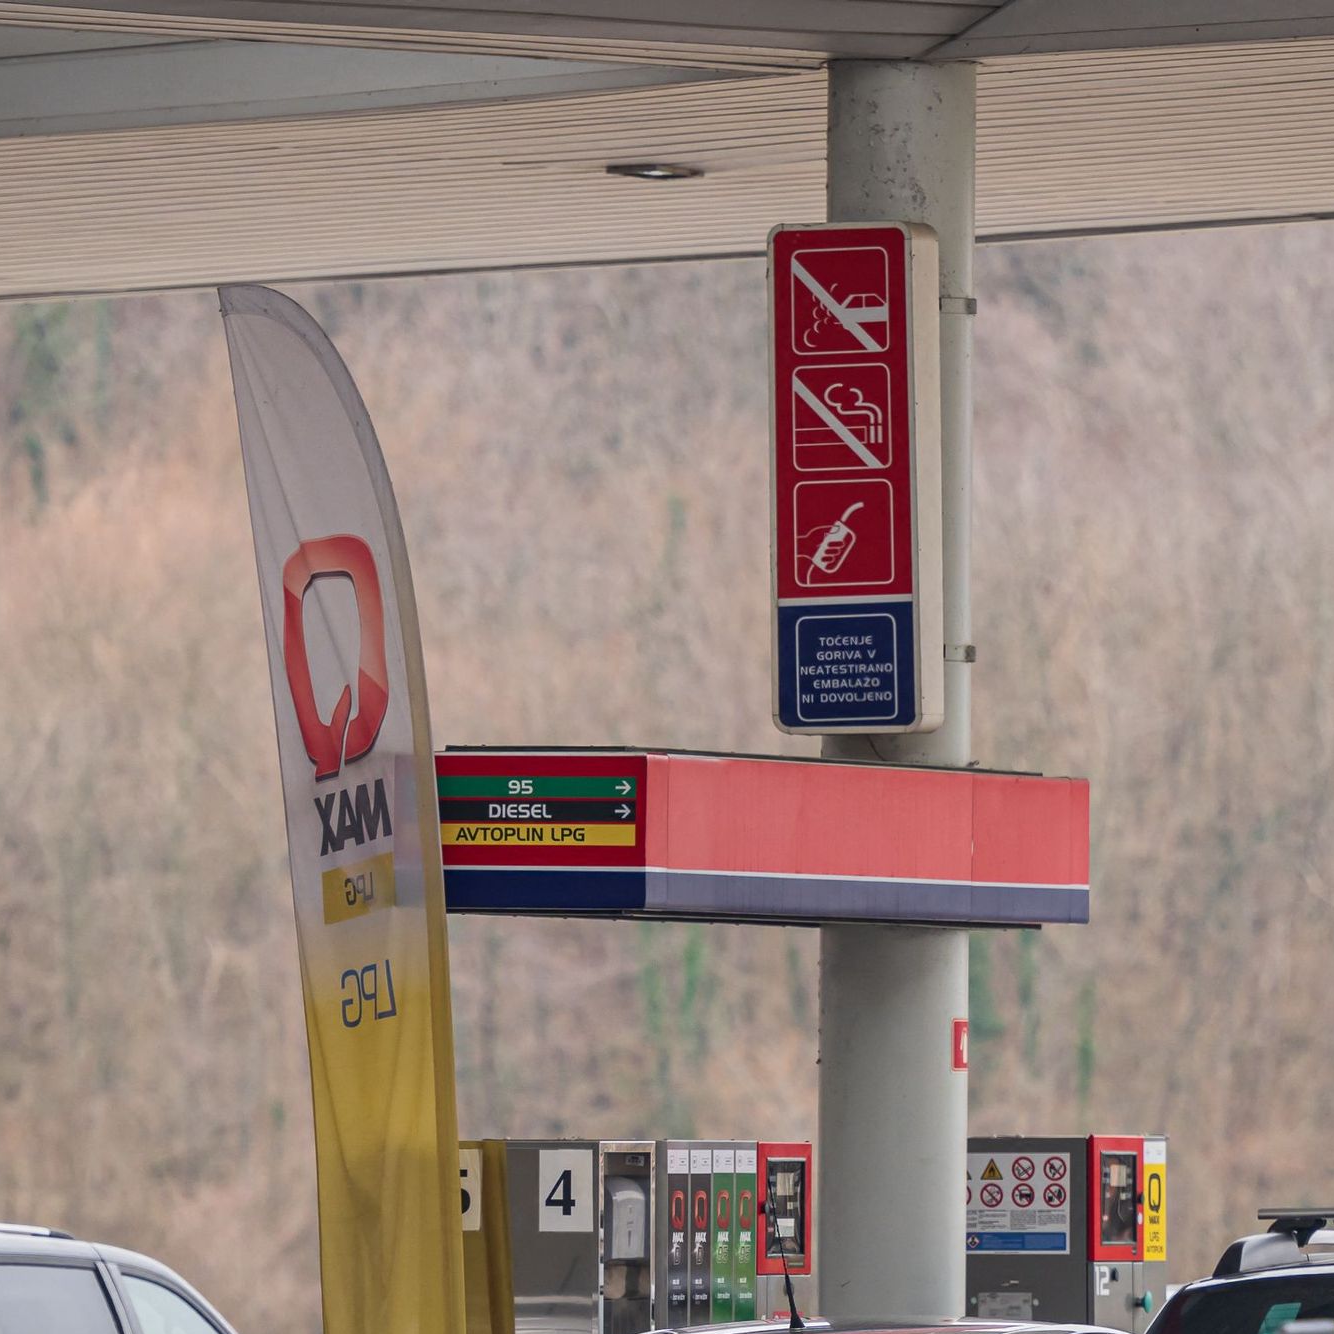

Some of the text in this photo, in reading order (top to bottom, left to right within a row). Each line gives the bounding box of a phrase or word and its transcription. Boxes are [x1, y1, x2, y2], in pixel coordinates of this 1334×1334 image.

[819, 634, 873, 647] TOČENJE
[816, 650, 876, 661] GORIVA V
[800, 663, 893, 676] NEATESTIRANO
[802, 691, 892, 704] NI DOVOLJENO
[508, 780, 534, 795] 95
[488, 803, 552, 819] DIESEL
[456, 827, 585, 842] AVTOPLIN LPG
[545, 1169, 576, 1216] 4
[1095, 1265, 1110, 1296] 12
